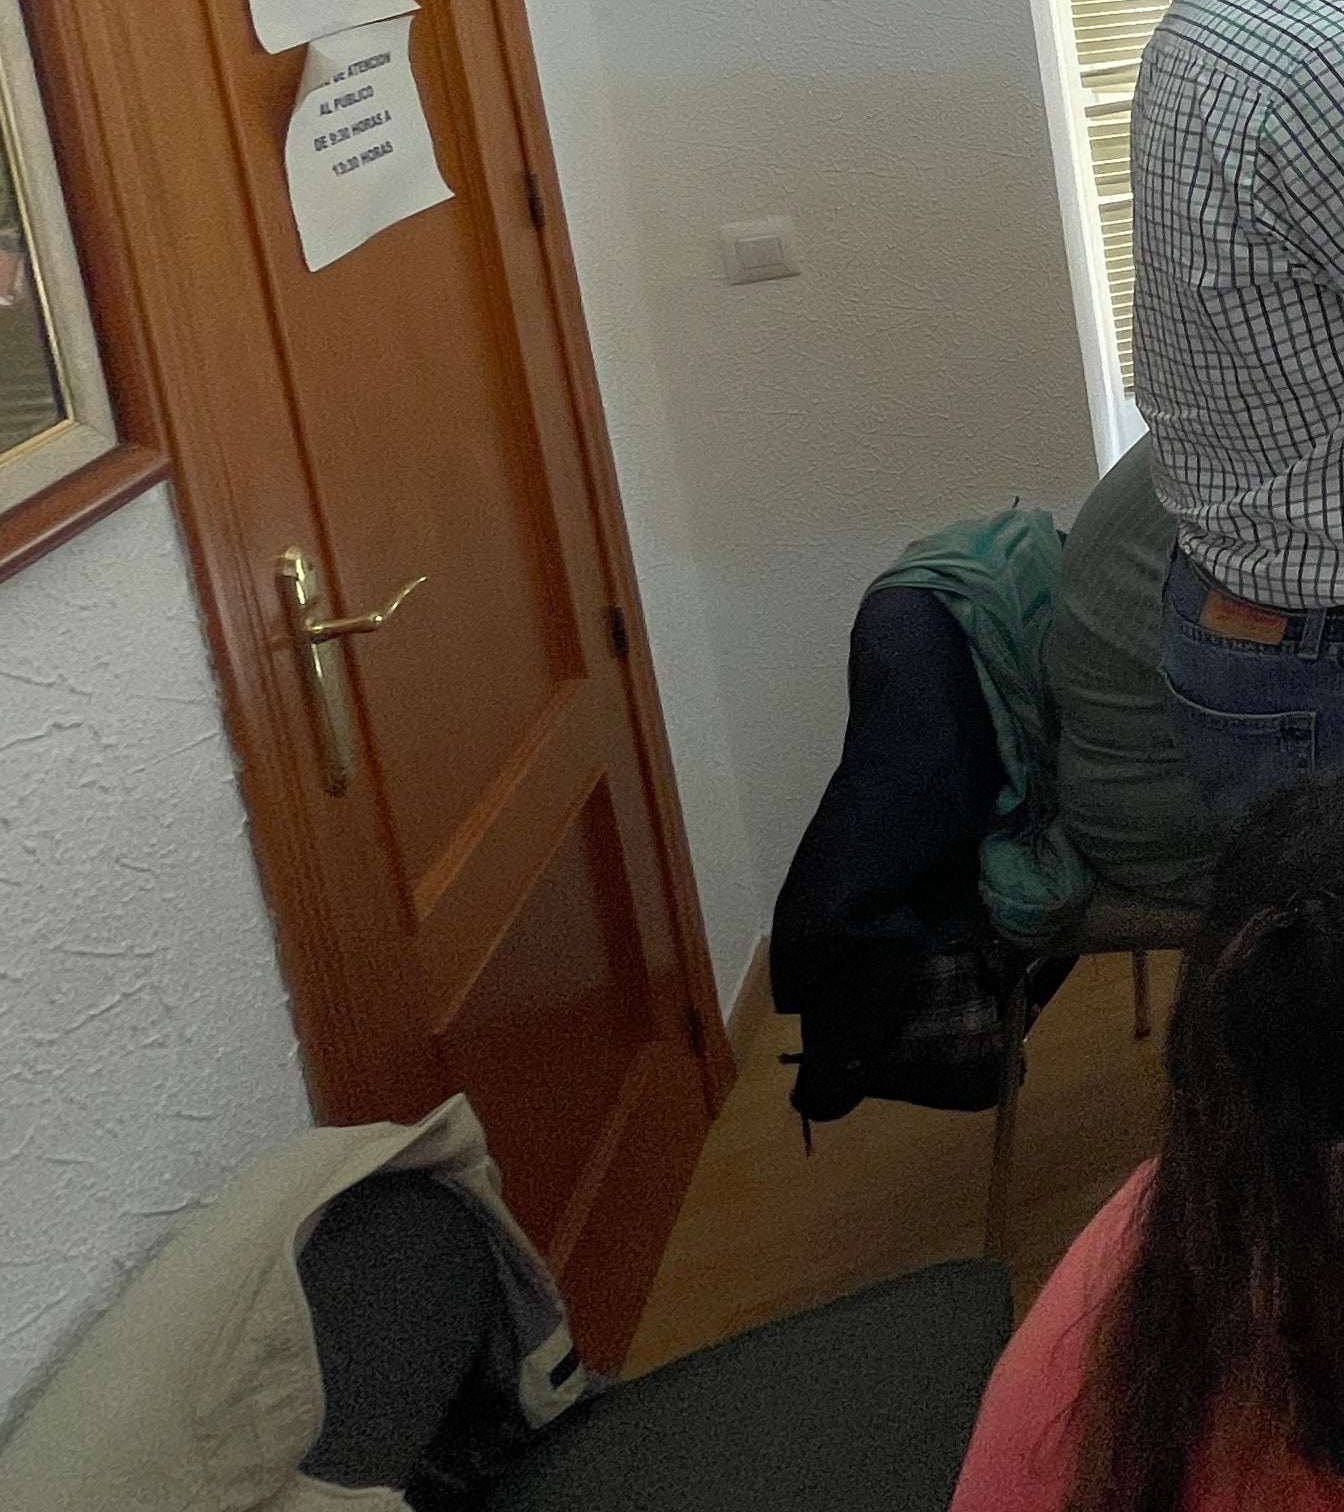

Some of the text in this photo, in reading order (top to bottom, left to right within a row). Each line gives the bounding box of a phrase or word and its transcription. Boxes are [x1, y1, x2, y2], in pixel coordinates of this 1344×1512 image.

[314, 135, 329, 151] DE
[351, 112, 383, 136] HORAS
[384, 110, 392, 122] A
[360, 141, 394, 165] HORAS
